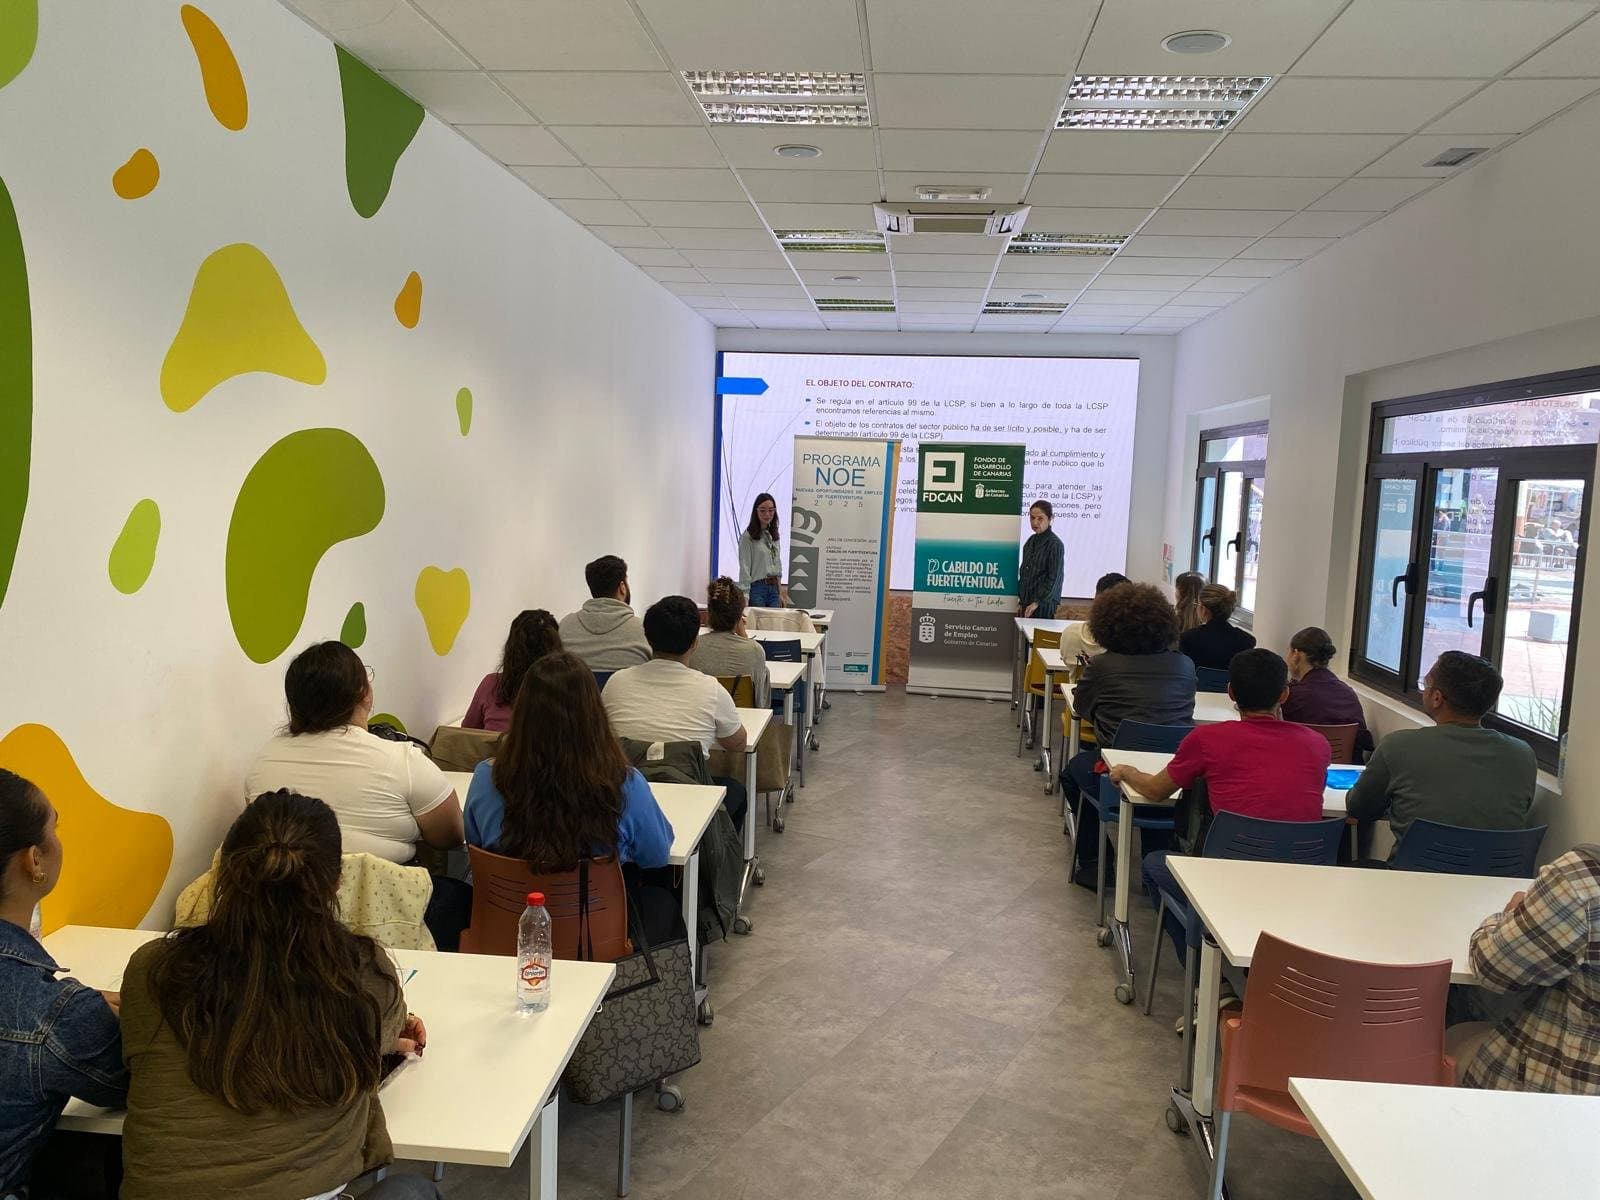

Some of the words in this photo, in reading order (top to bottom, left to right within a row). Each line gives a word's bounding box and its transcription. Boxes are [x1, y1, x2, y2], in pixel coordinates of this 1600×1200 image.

[817, 380, 849, 388] OBJETO
[868, 381, 914, 389] CONTRATO:
[830, 399, 852, 407] regula
[1019, 402, 1038, 411] largo
[824, 421, 846, 429] objeto
[871, 422, 904, 430] contratos
[1026, 426, 1032, 434] y
[1049, 450, 1099, 460] cumplimiento
[803, 454, 880, 467] PROGRAMA
[815, 467, 865, 487] NOE
[1035, 483, 1053, 491] para
[922, 492, 963, 503] FDCAN
[1039, 491, 1049, 499] 28
[1062, 492, 1069, 500] la
[1083, 503, 1102, 511] pero
[942, 560, 983, 574] CABILDO
[985, 562, 999, 575] DE
[926, 574, 1005, 589] FUERTEVENTURA
[944, 623, 971, 631] Servicio
[953, 632, 978, 640] Empleo
